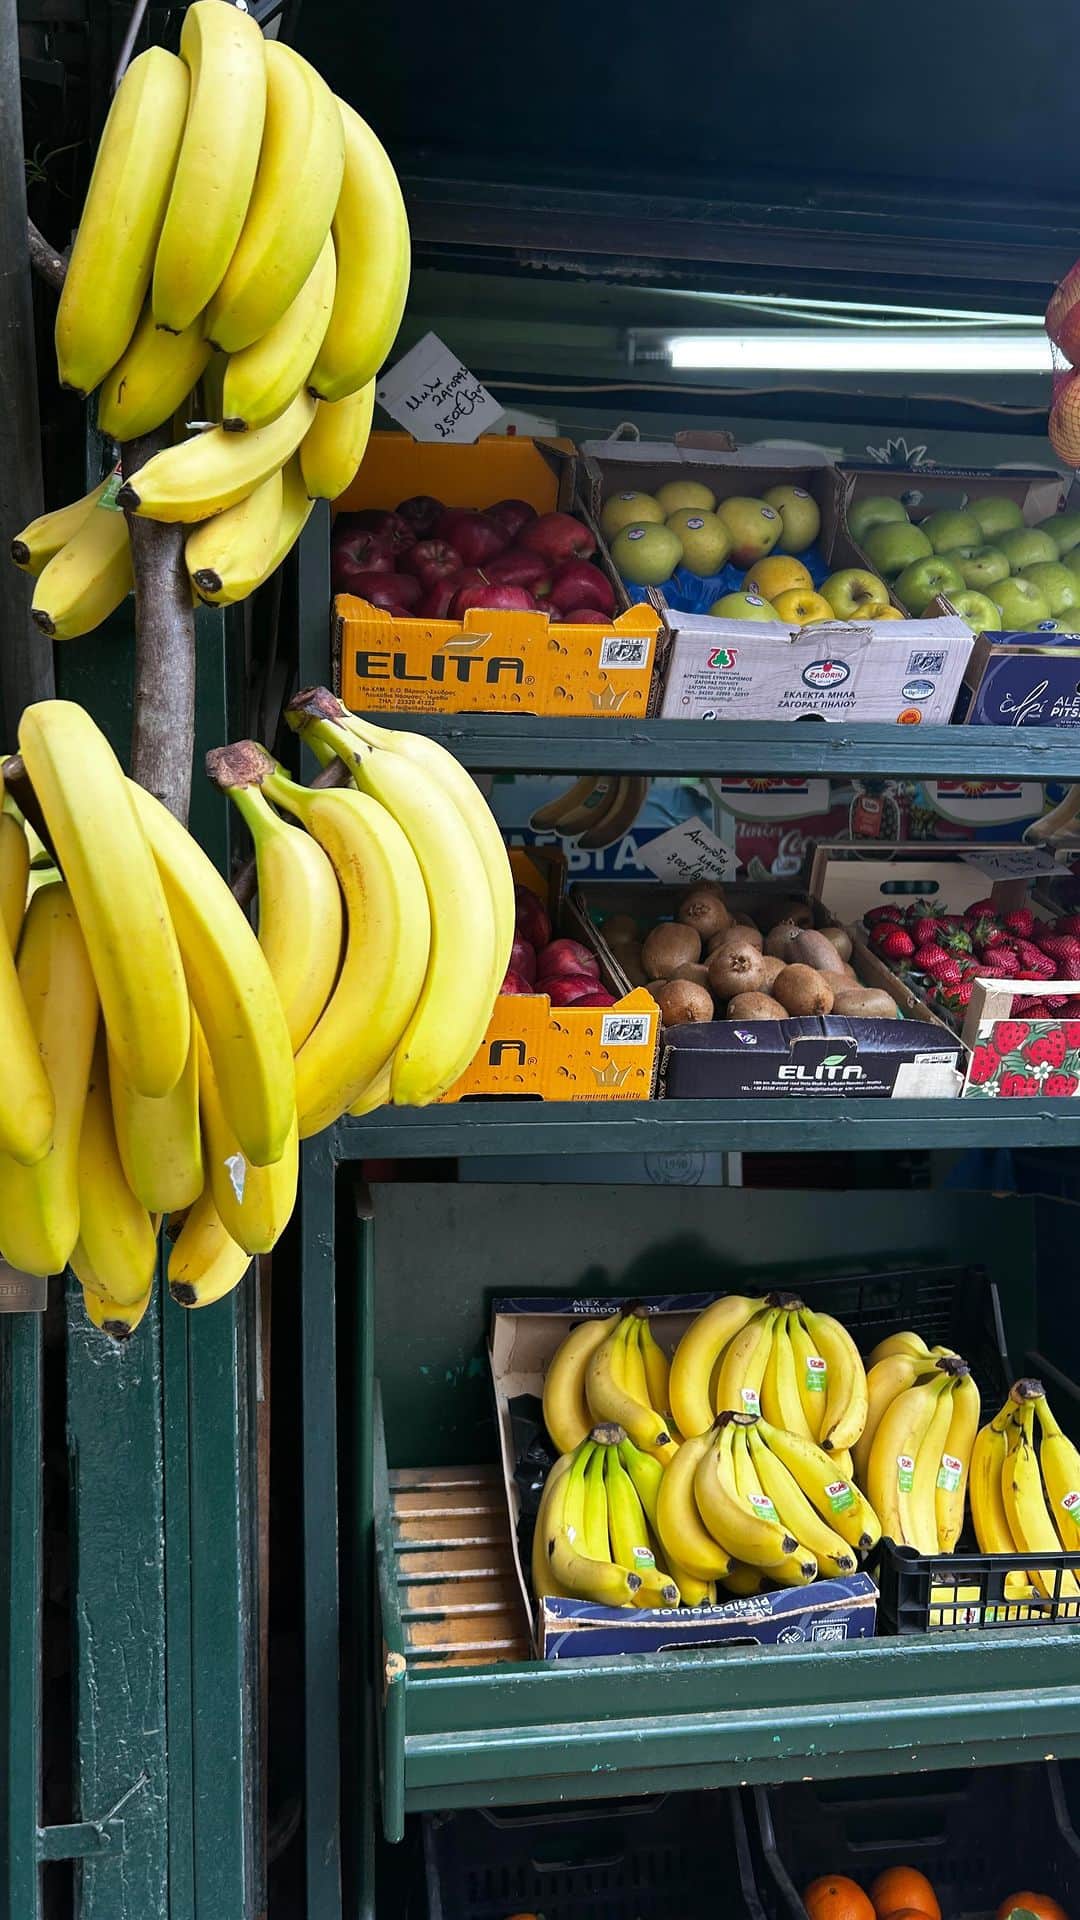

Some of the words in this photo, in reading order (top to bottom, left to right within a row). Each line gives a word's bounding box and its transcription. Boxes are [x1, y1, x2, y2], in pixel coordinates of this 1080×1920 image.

[355, 650, 524, 685] ELITA
[809, 671, 844, 680] ZAGORIN
[783, 691, 825, 699] ΕΚΛΕΚΤΑ
[827, 691, 856, 699] ΜΗΛΑ
[777, 700, 819, 709] ΖΑΓΟΡΑΣ
[820, 700, 857, 709] ΠΗΛΙΟΥ
[1050, 706, 1080, 718] PITS
[777, 1064, 863, 1081] ELITA
[572, 1299, 601, 1307] ALEX
[809, 1359, 825, 1369] Dole
[829, 1481, 847, 1496] Dole
